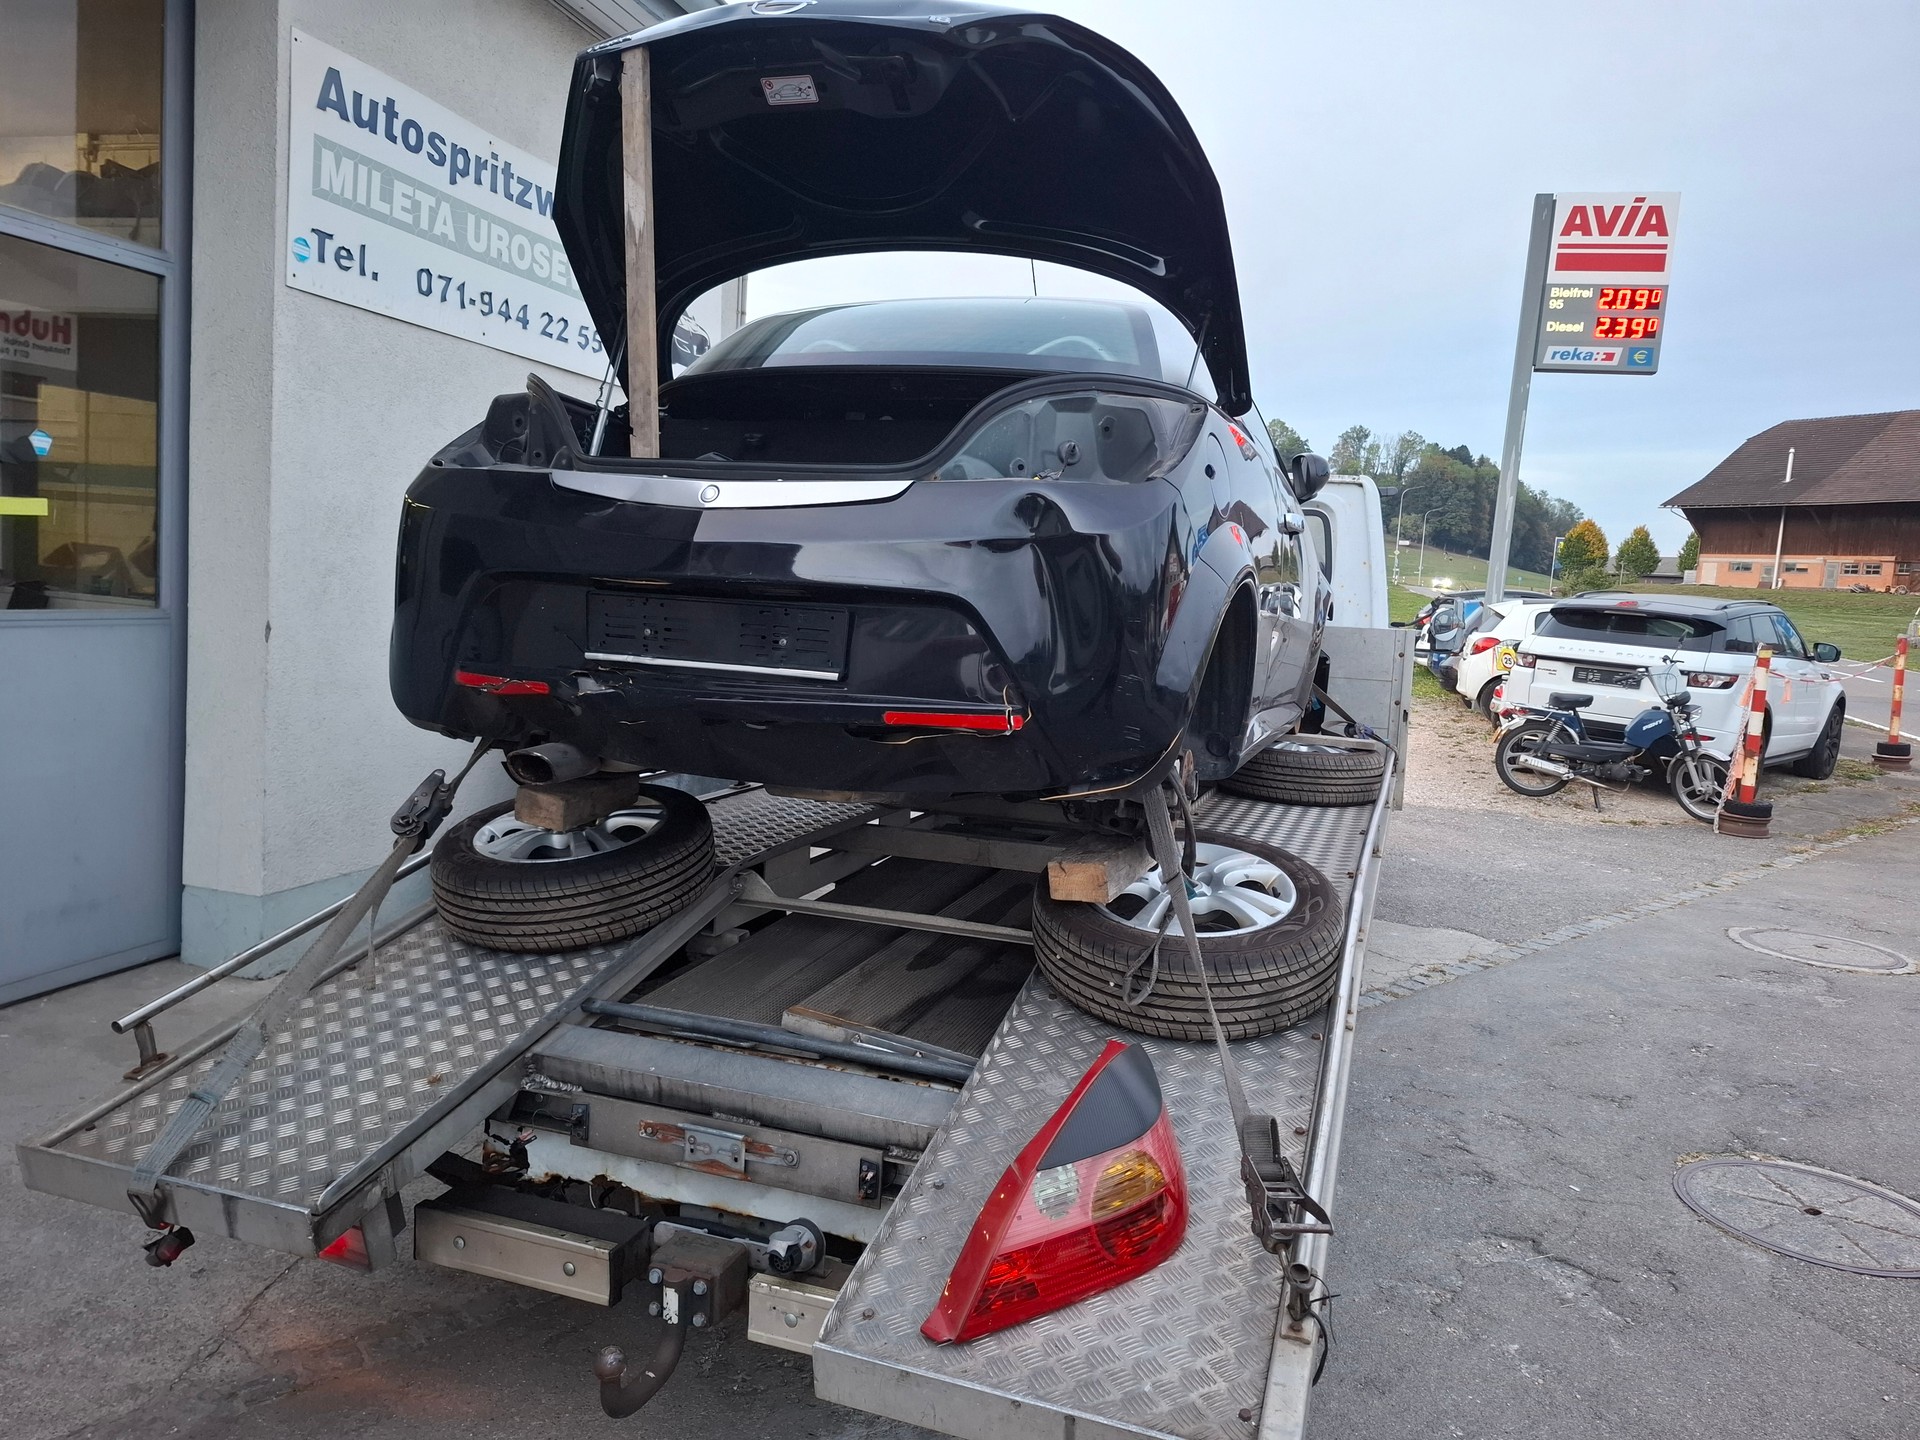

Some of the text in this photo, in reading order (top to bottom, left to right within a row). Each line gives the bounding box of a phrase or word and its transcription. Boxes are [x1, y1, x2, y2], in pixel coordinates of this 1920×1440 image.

[319, 146, 581, 292] MILETA UROSE
[310, 228, 603, 354] Tel. 071-944 22 55
[1549, 299, 1564, 309] 95
[1546, 321, 1584, 332] Diesel
